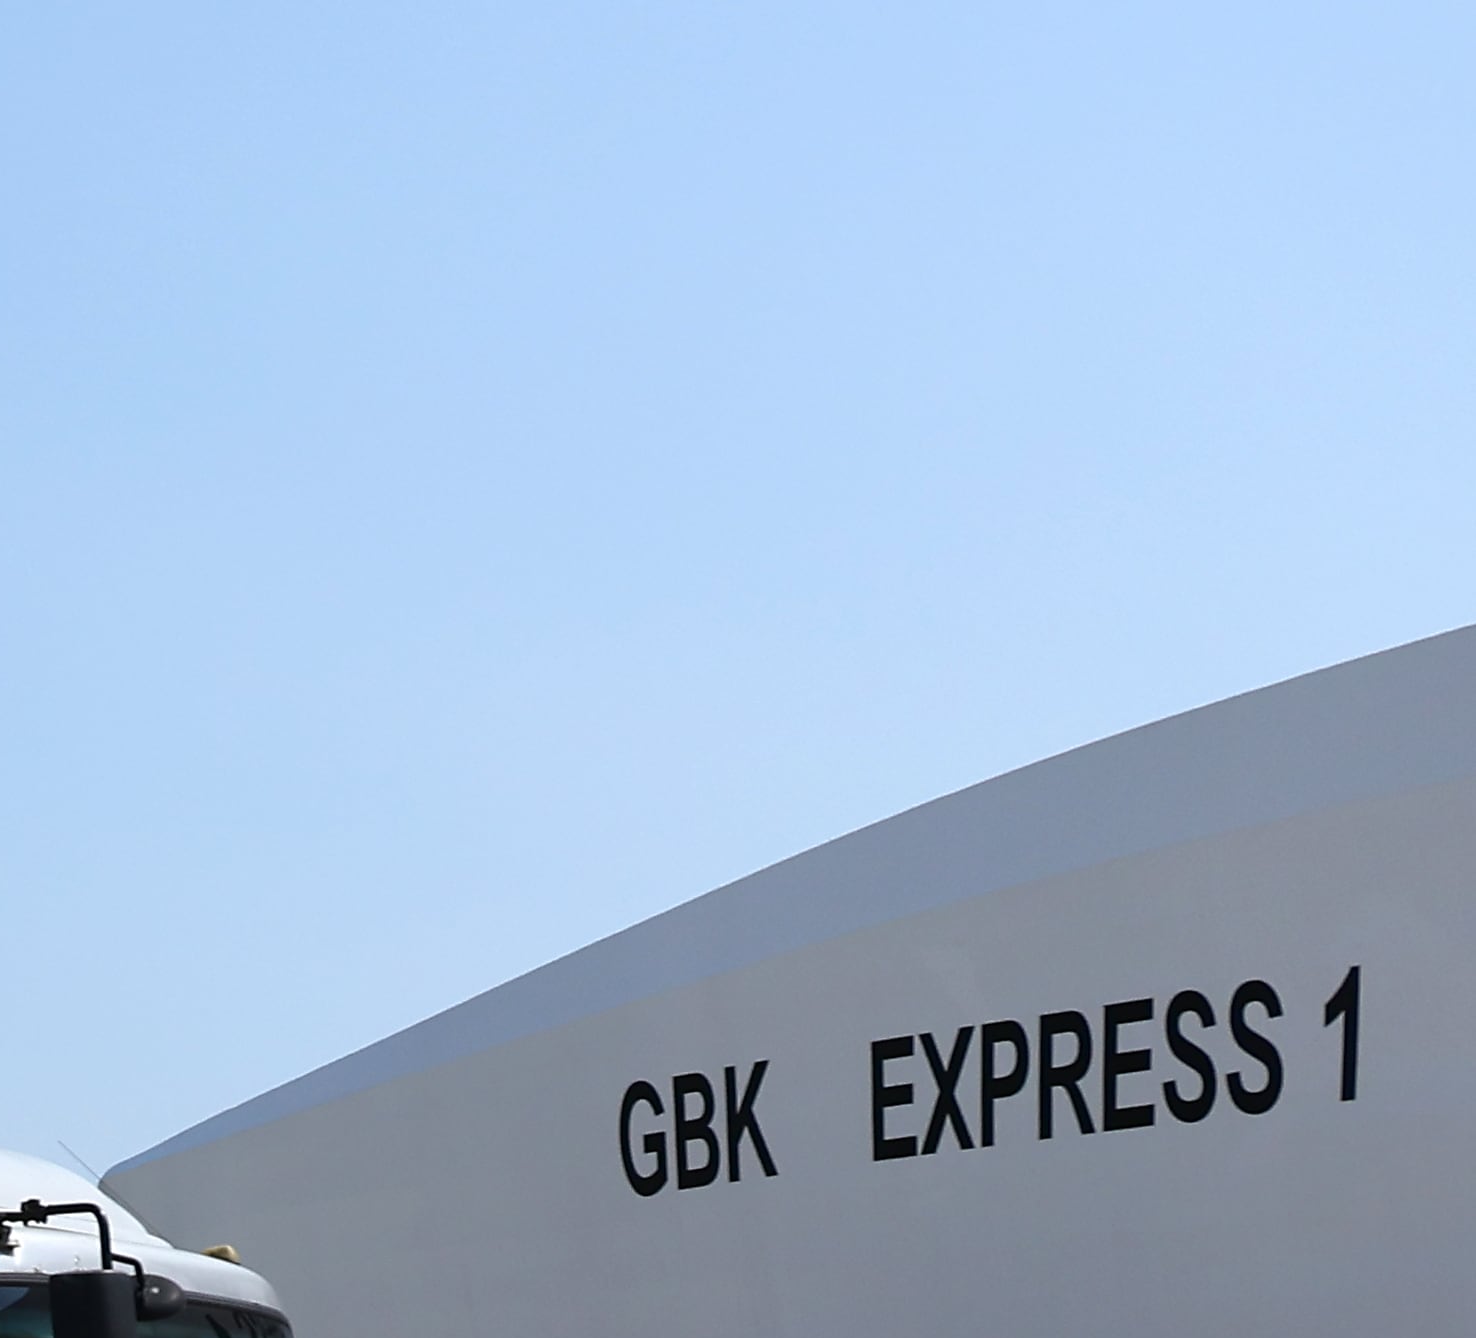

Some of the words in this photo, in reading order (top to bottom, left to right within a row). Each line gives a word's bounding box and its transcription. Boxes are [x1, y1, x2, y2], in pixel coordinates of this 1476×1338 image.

[618, 1060, 778, 1197] GBK
[870, 979, 1283, 1163] EXPRESS
[1324, 966, 1362, 1102] 1
